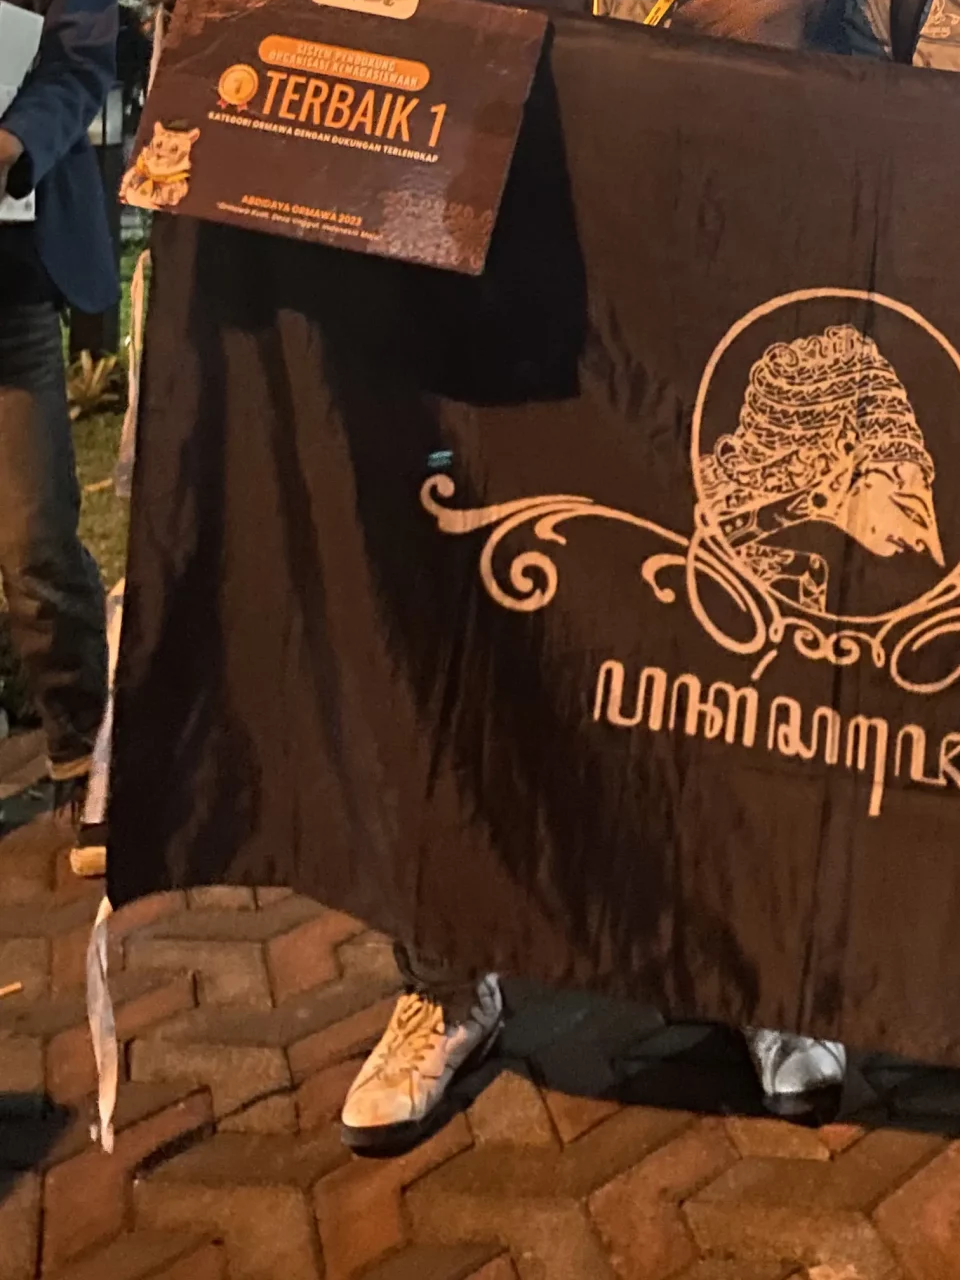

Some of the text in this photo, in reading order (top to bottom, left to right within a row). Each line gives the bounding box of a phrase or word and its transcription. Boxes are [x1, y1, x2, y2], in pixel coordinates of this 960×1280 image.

[208, 111, 252, 128] KATEGORI
[293, 128, 331, 142] DENGAN
[331, 135, 382, 153] DUKUNGAN
[382, 144, 439, 163] TERLENGKAP
[262, 70, 448, 148] TERBAIK 1
